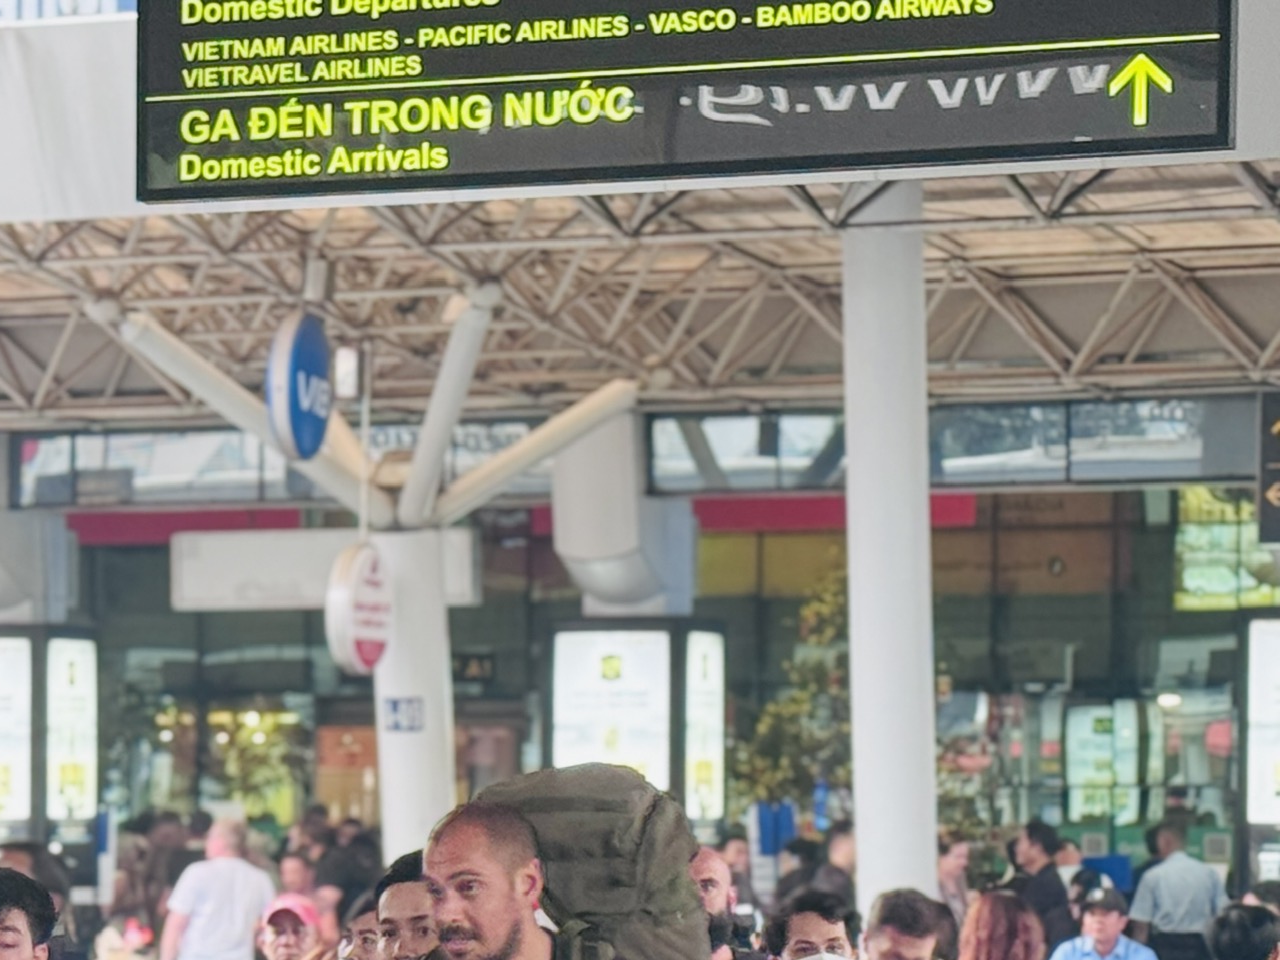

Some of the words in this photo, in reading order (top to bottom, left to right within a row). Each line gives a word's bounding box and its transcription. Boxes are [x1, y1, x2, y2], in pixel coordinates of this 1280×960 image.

[181, 0, 323, 25] Domestic
[182, 37, 286, 62] VIETNAM
[289, 30, 399, 55] AIRLINES
[418, 23, 511, 49] PACIFIC
[515, 15, 629, 43] AIRLINES
[648, 8, 737, 34] VASCO
[756, 0, 872, 28] BAMBOO
[875, 0, 994, 20] AIRWAYS
[182, 61, 310, 89] VIETRAVEL
[313, 55, 422, 82] AIRLINES
[180, 109, 241, 144] GA
[343, 94, 493, 138] TRONG
[504, 81, 636, 128] NƯỚC
[180, 149, 322, 182] Domestic
[327, 143, 448, 176] Arrivals
